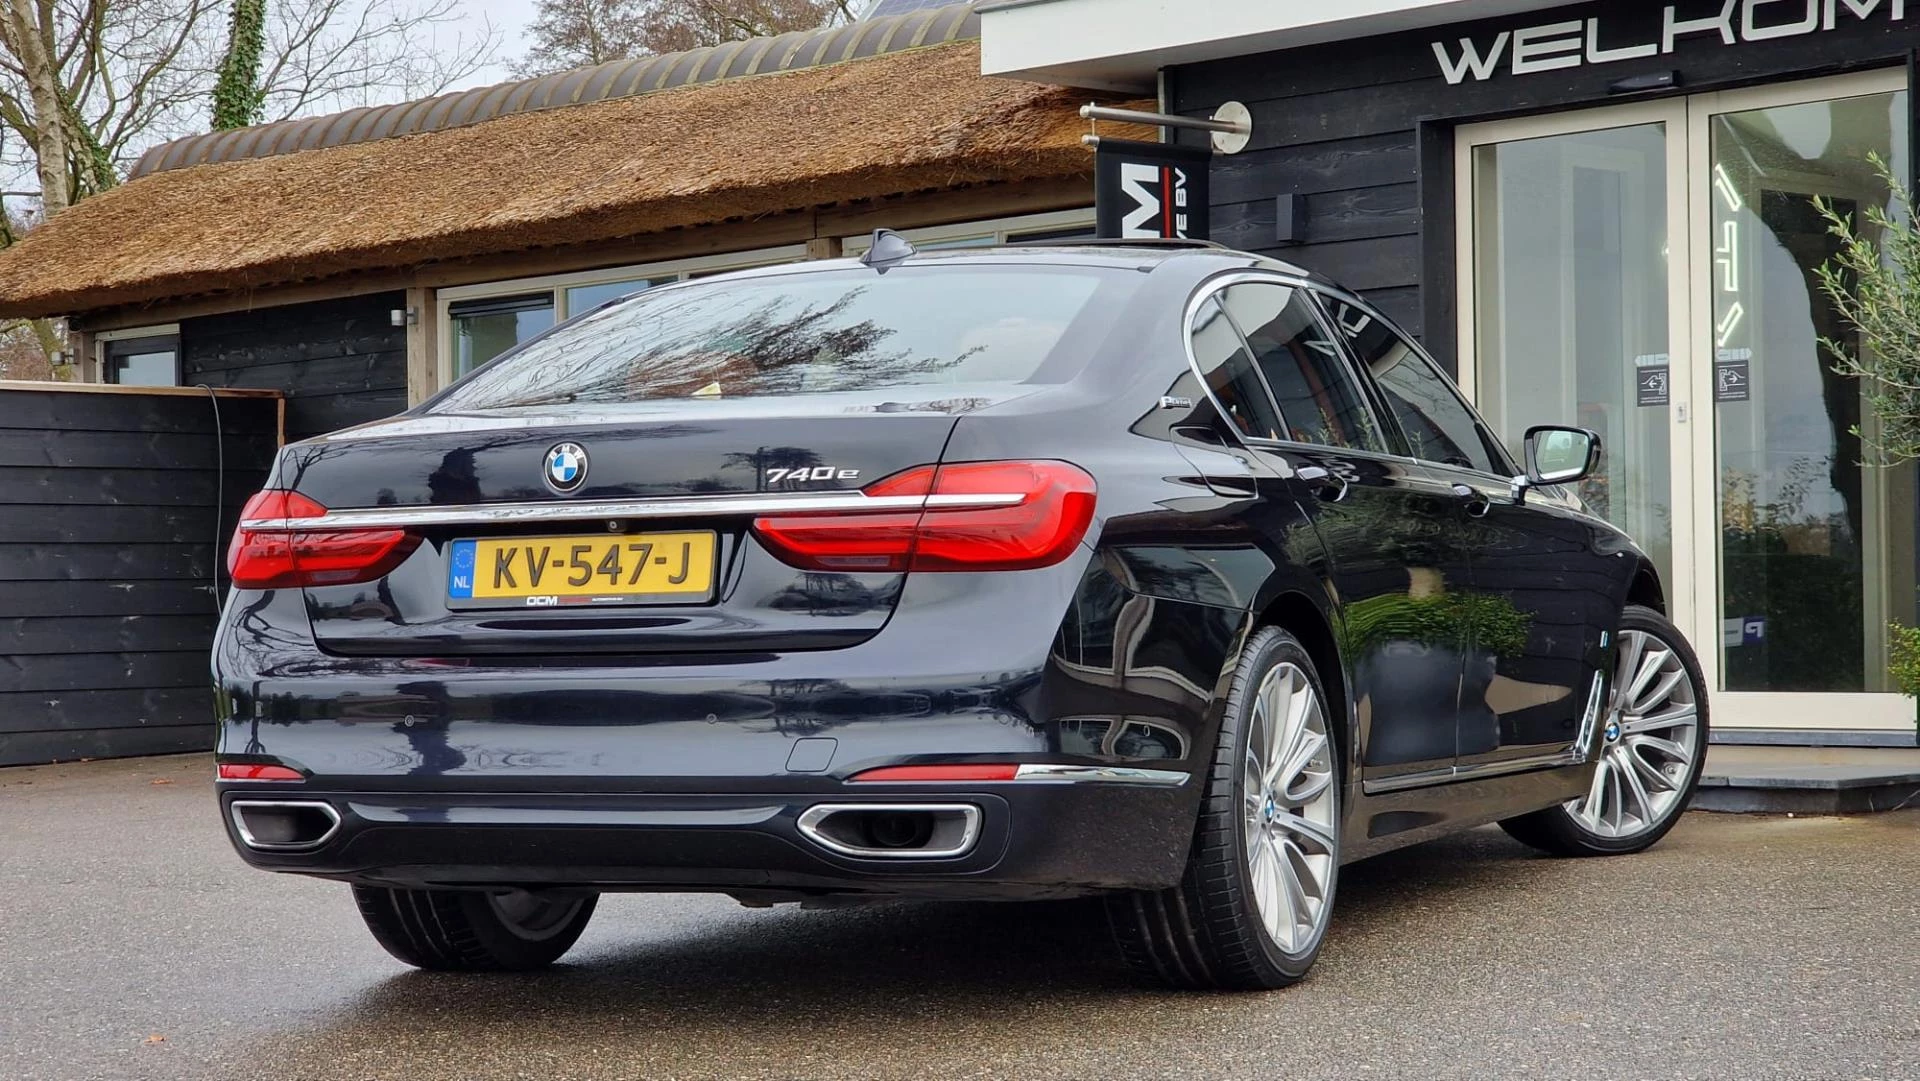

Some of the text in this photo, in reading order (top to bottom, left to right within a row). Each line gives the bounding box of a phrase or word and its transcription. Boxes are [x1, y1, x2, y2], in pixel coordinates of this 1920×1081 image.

[1431, 0, 1904, 85] WELKOM
[1174, 167, 1188, 207] BV
[549, 444, 585, 460] BMW
[766, 466, 860, 483] 740e
[493, 542, 691, 589] KV-547-J
[453, 576, 471, 589] NL
[526, 596, 558, 606] OCM
